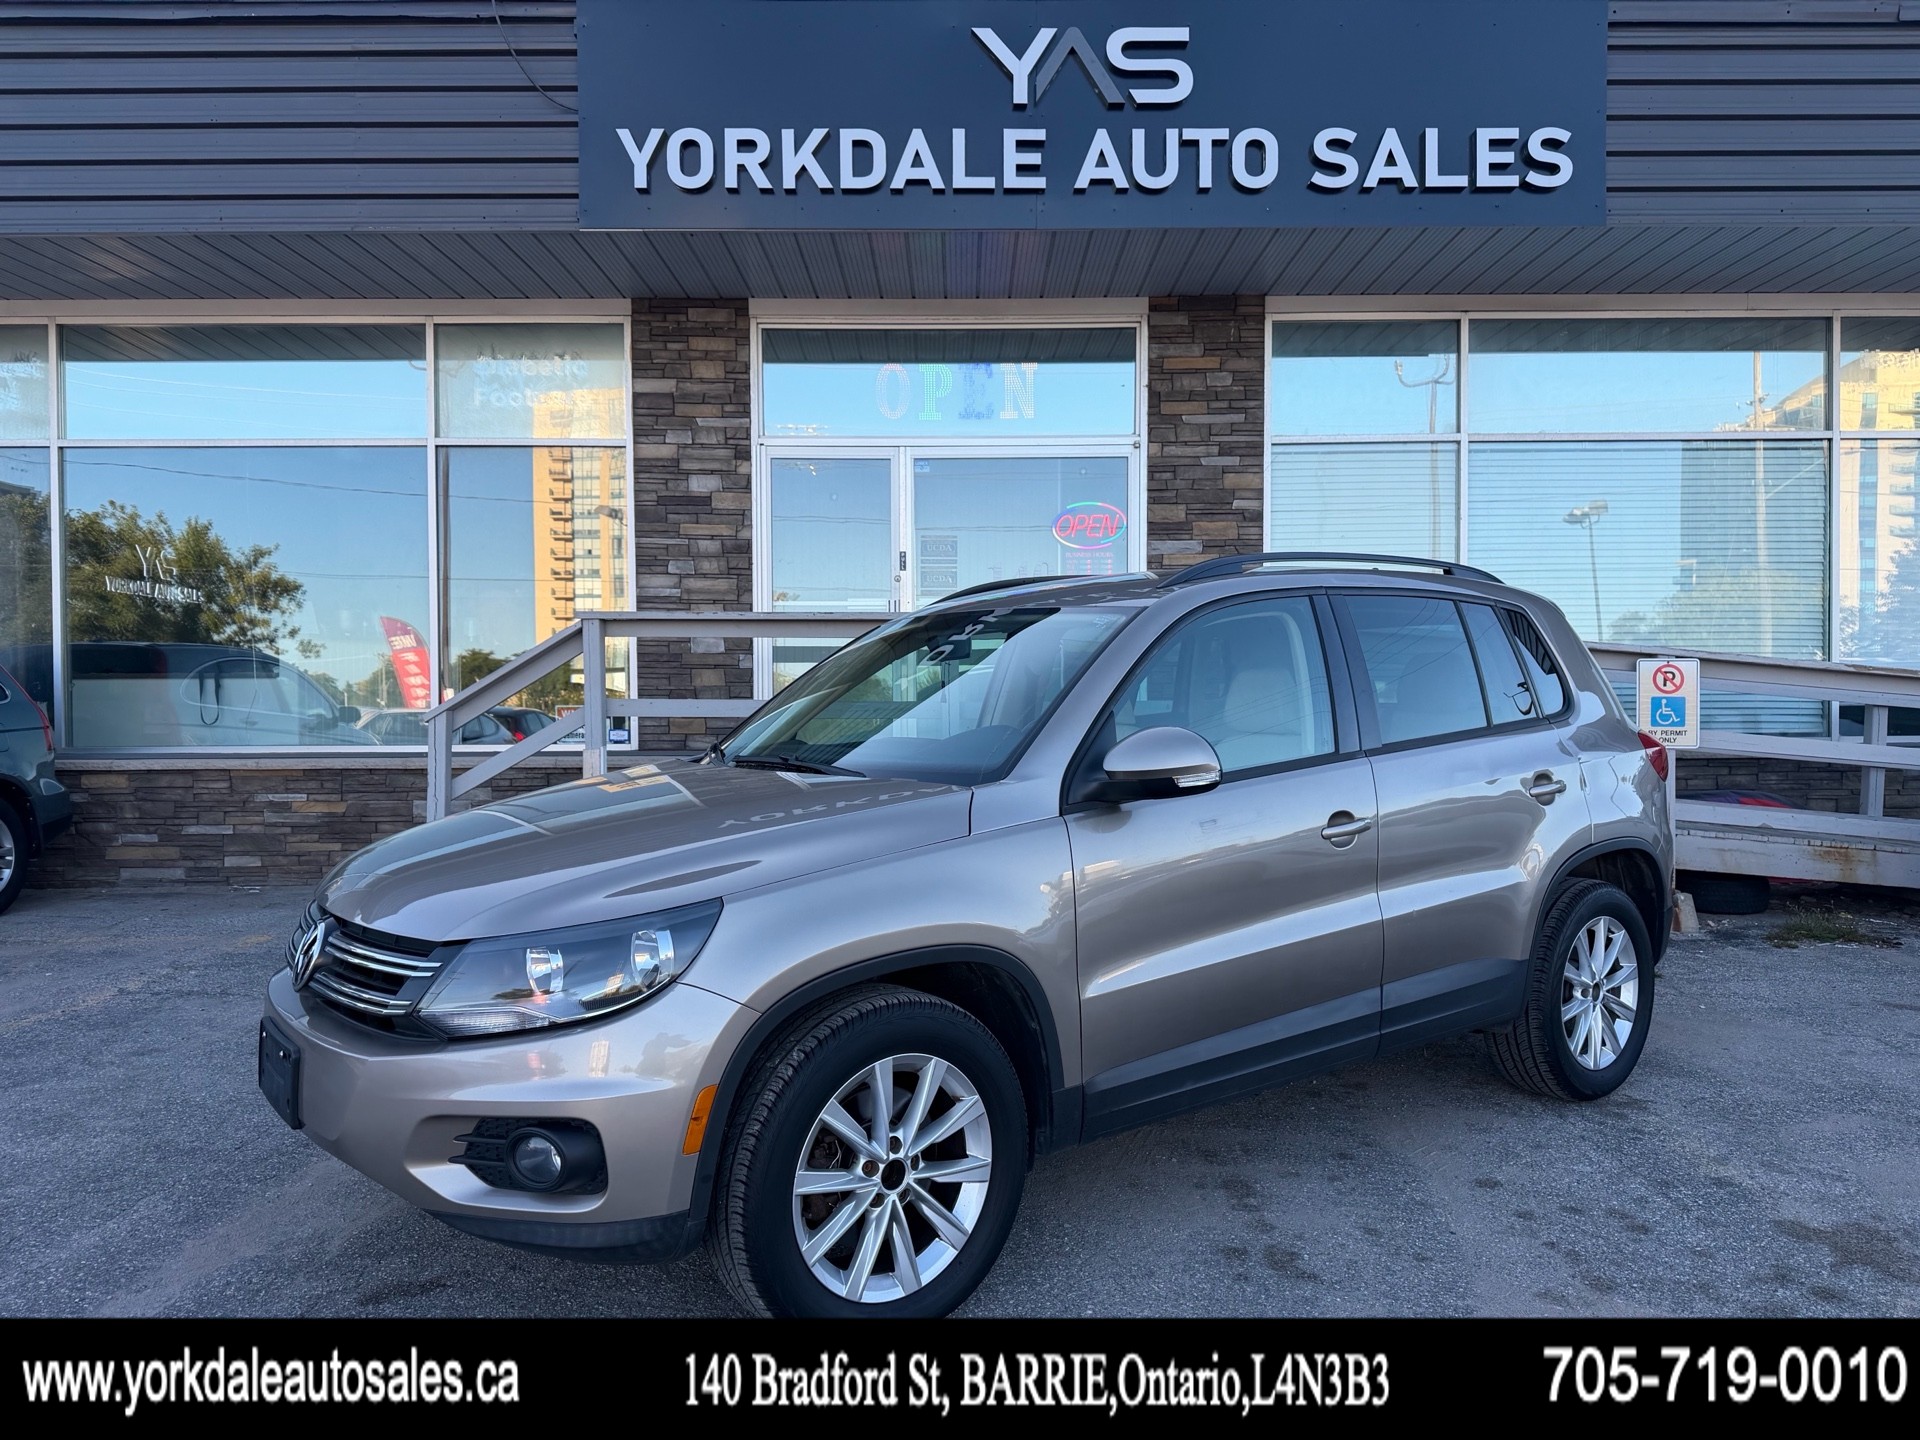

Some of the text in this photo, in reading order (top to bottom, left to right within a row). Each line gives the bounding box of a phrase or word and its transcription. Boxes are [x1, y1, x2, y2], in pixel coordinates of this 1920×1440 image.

[971, 26, 1194, 106] YAS
[615, 126, 1574, 191] YORKDALE AUTO SALES
[875, 362, 1038, 421] OPEN
[926, 544, 953, 552] UCDA
[1055, 513, 1120, 538] OPEN
